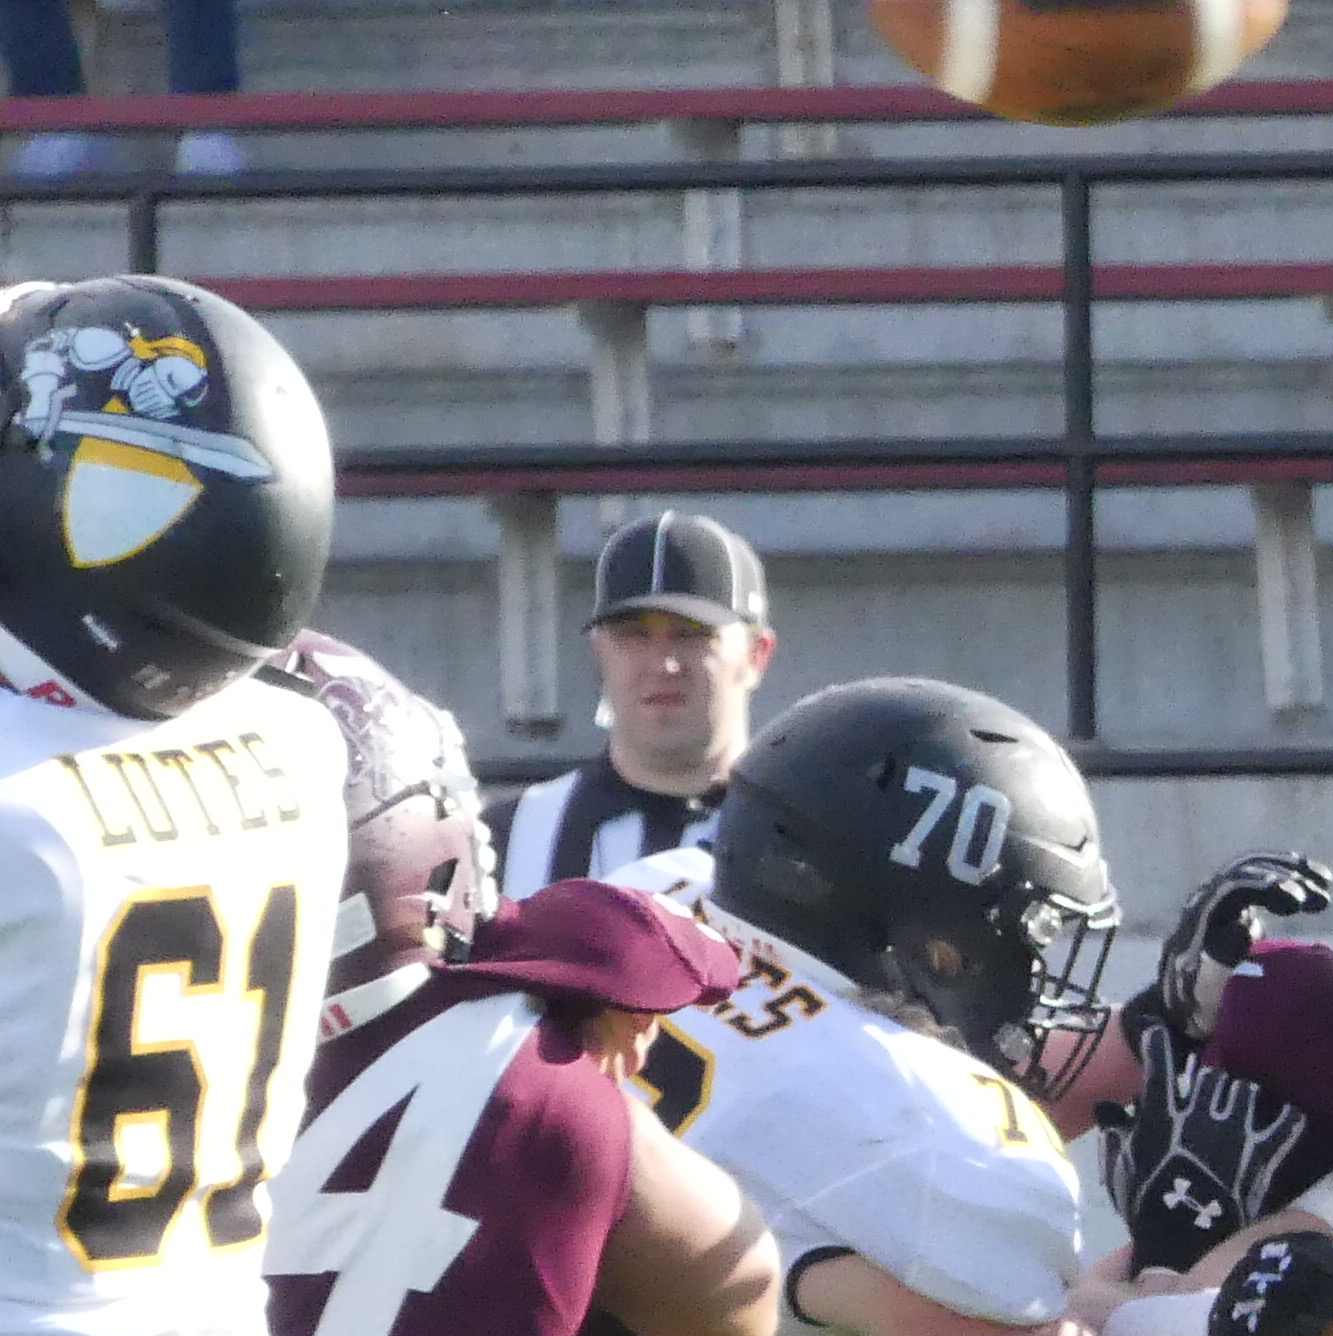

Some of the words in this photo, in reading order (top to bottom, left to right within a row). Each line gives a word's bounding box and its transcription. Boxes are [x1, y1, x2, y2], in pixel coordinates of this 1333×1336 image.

[55, 732, 300, 846] LUTES
[890, 766, 1012, 886] 70
[56, 881, 298, 1273] 61
